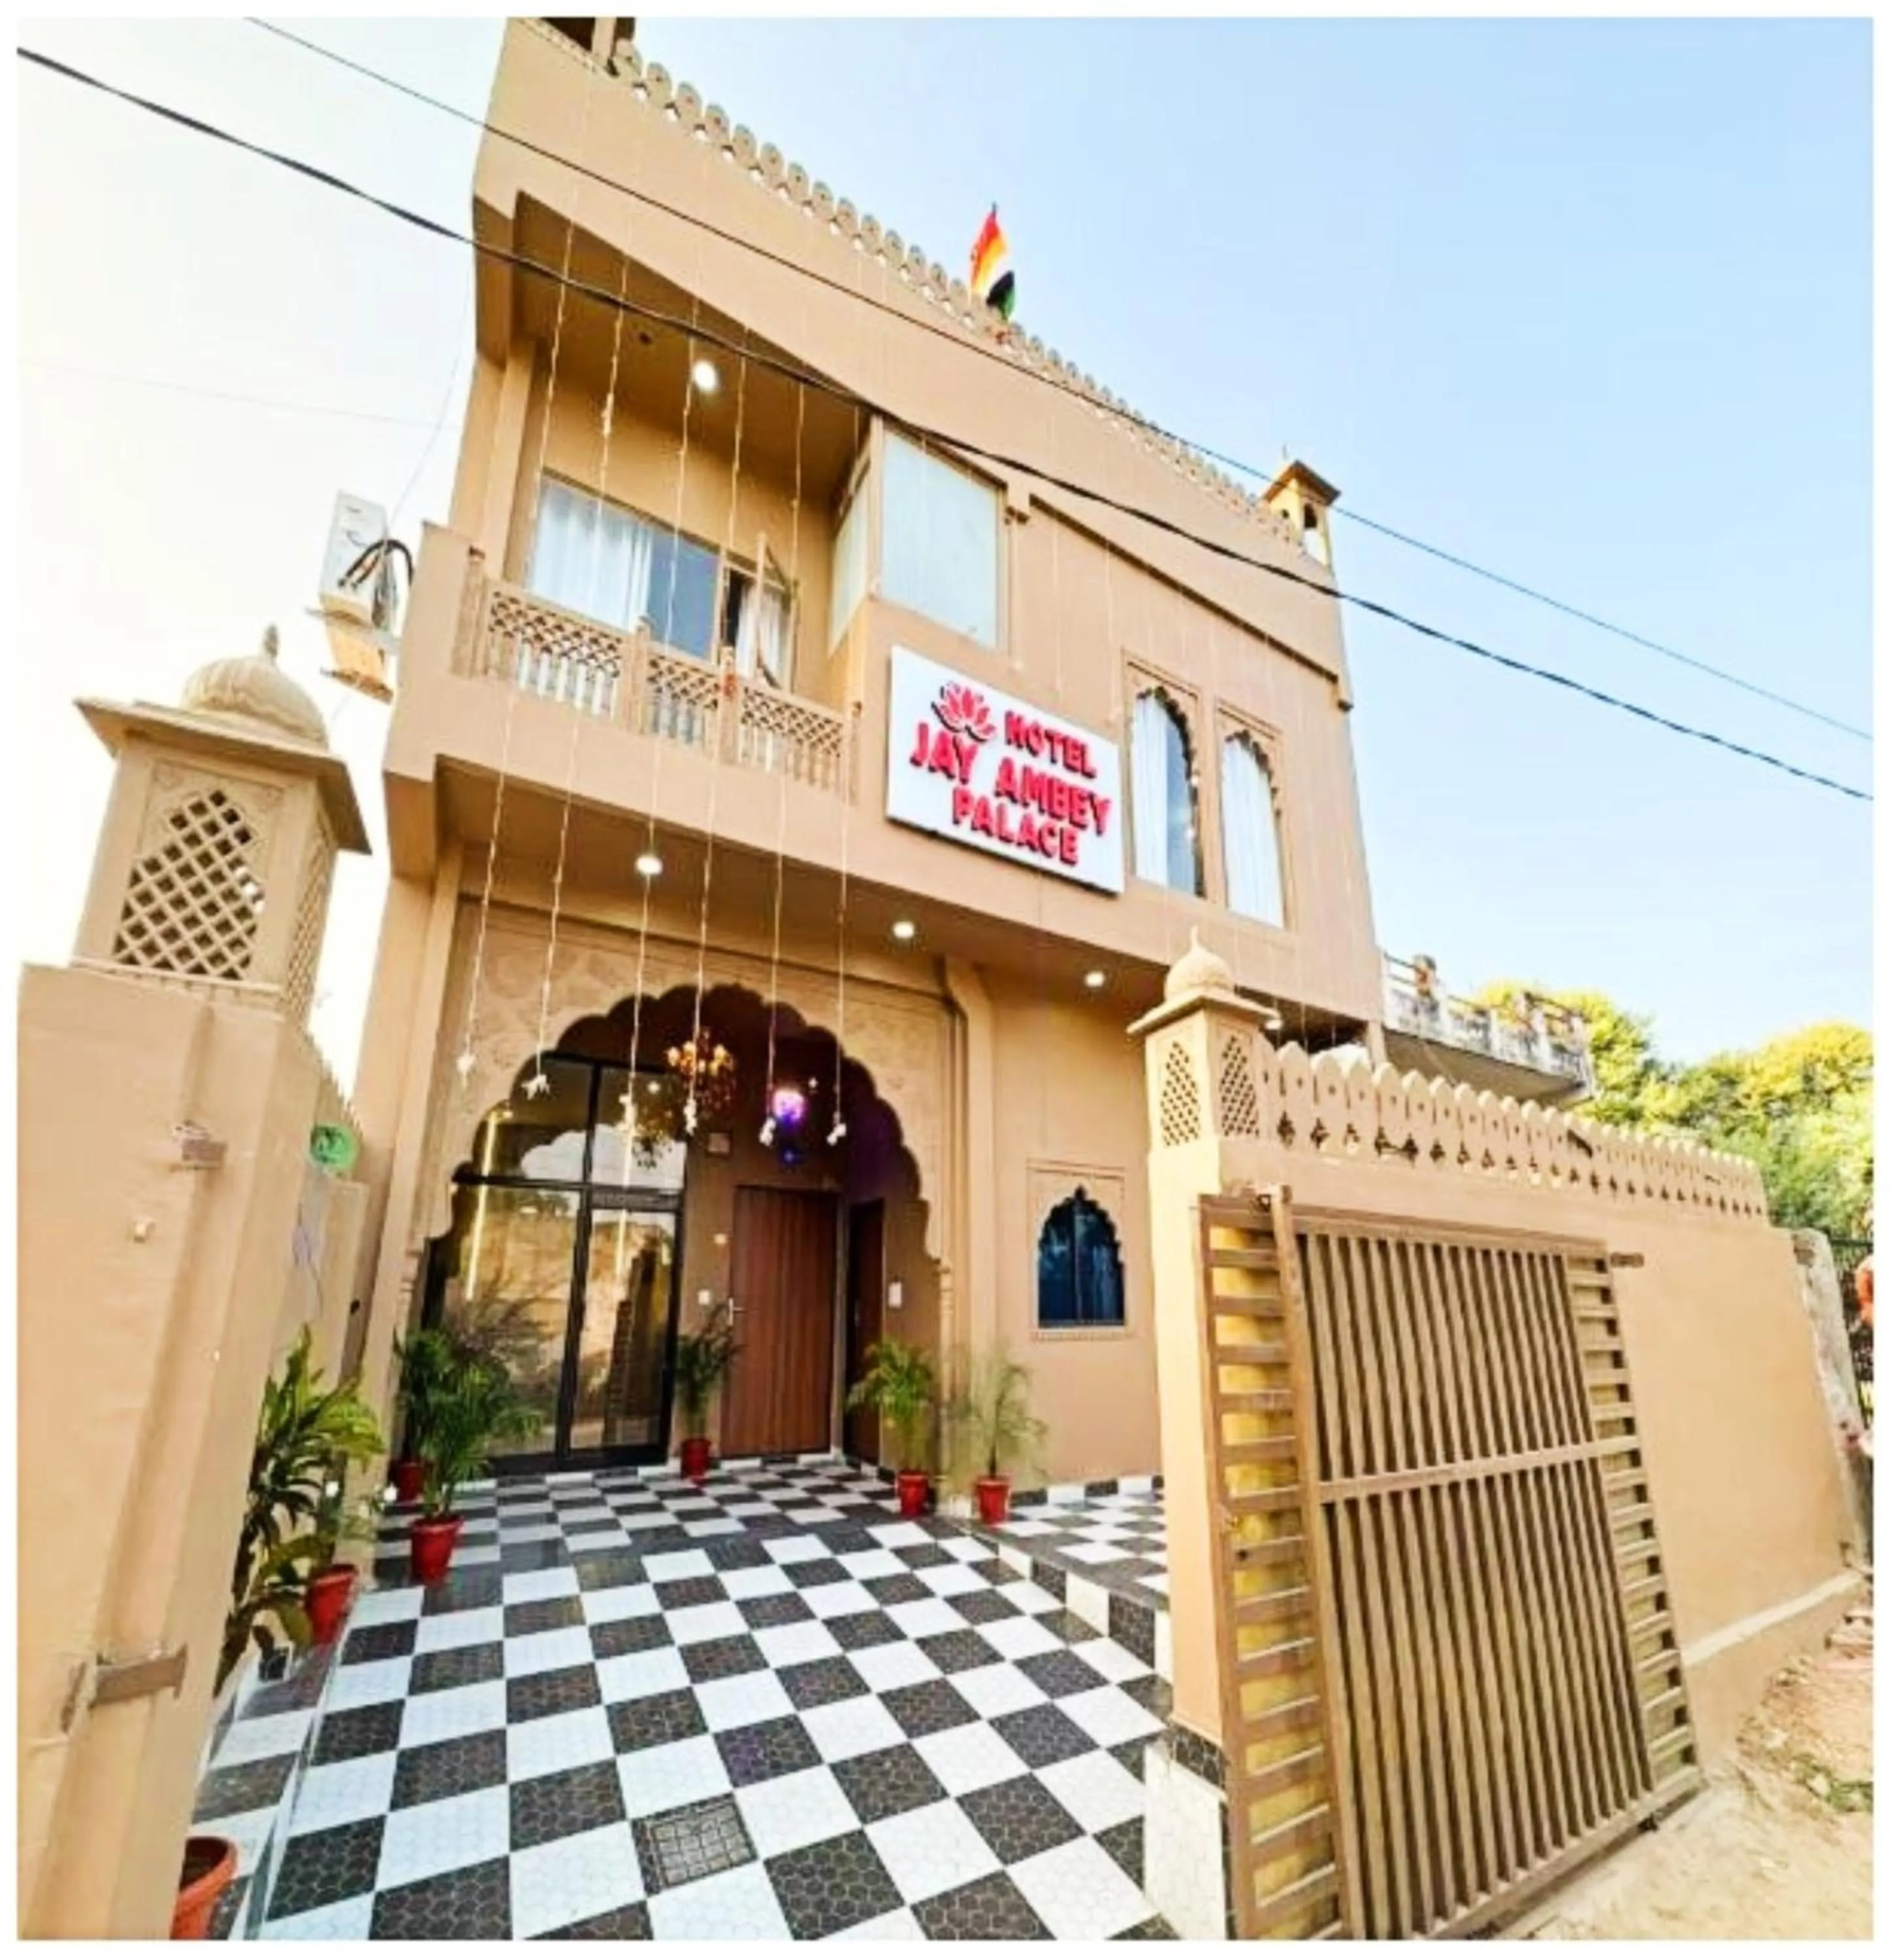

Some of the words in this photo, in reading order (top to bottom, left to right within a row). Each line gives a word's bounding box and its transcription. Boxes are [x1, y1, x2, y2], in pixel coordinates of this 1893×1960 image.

[910, 722, 979, 784] JAY
[994, 757, 1110, 836] AMBEY
[1005, 710, 1097, 779] HOTEL
[952, 787, 1078, 866] PALACE
